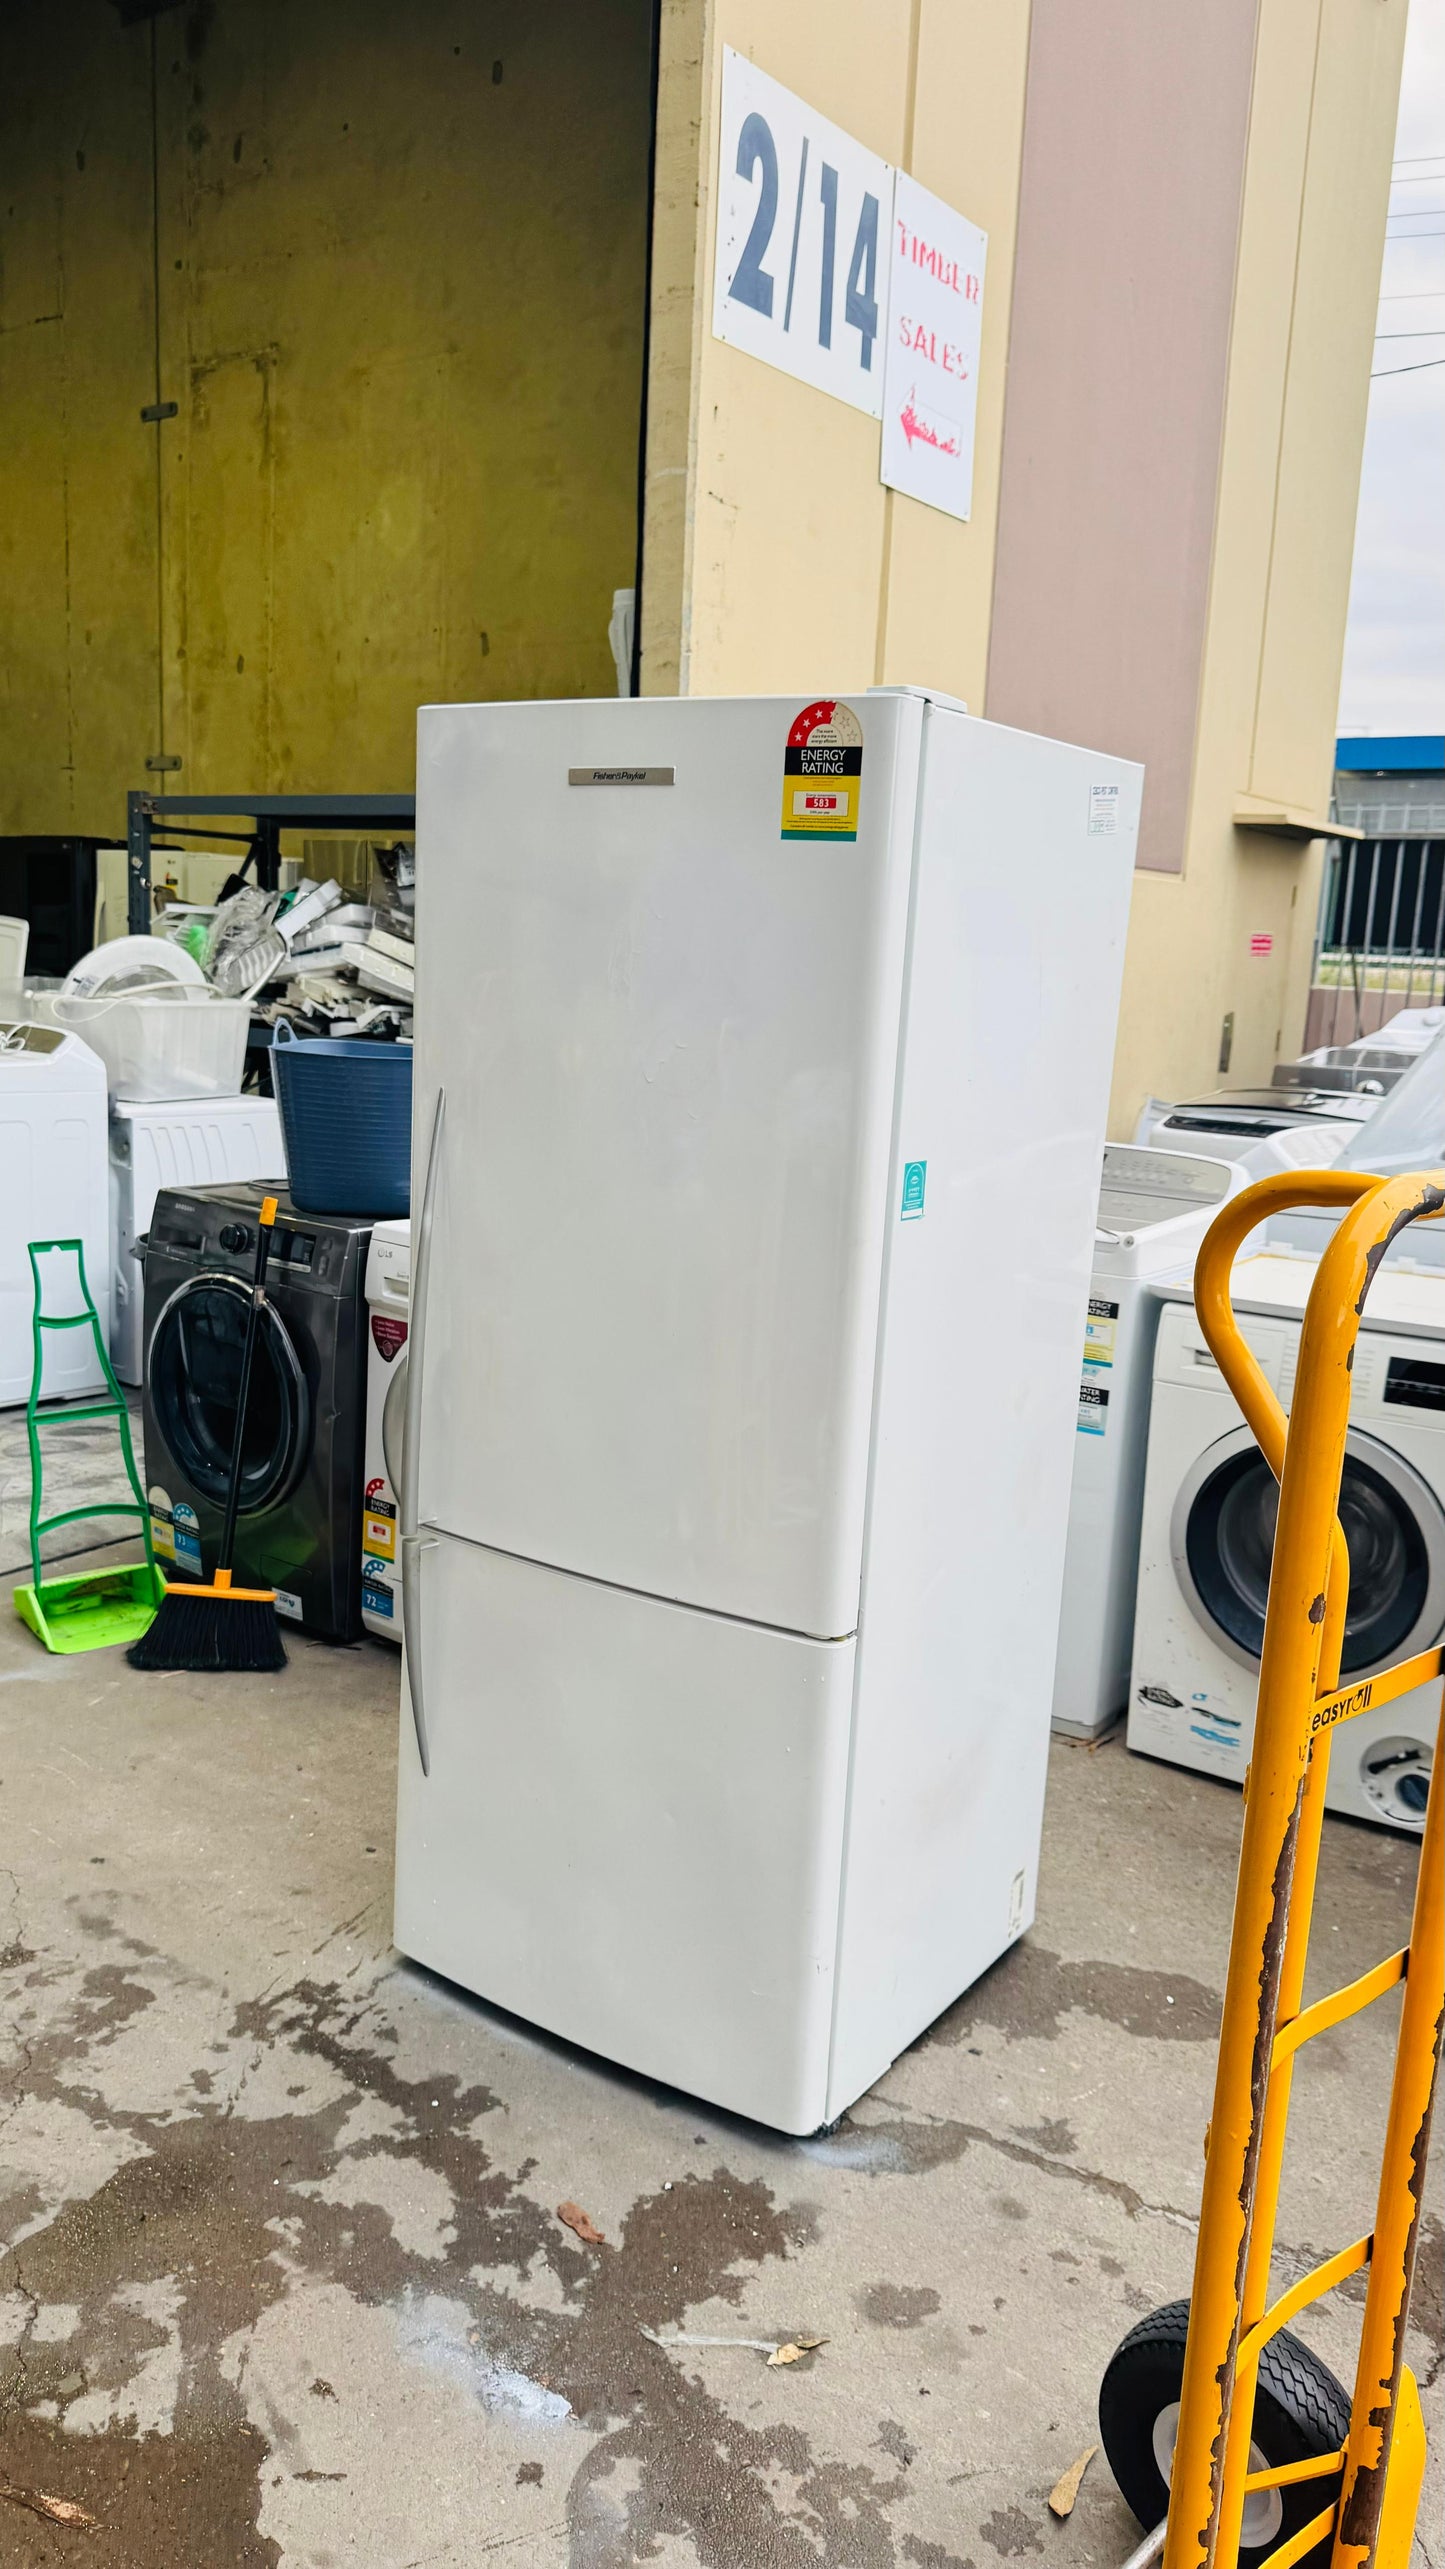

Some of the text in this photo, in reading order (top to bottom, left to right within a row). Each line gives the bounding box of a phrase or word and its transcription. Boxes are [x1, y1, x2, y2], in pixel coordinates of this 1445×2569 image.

[728, 112, 879, 372] 2/14
[897, 218, 980, 305] TIMBER
[900, 316, 969, 380] SALES
[800, 749, 847, 761] ENERGY
[801, 762, 844, 774] RATING
[813, 798, 830, 808] 583
[366, 1594, 377, 1607] 72
[1312, 1683, 1373, 1732] easyroll
